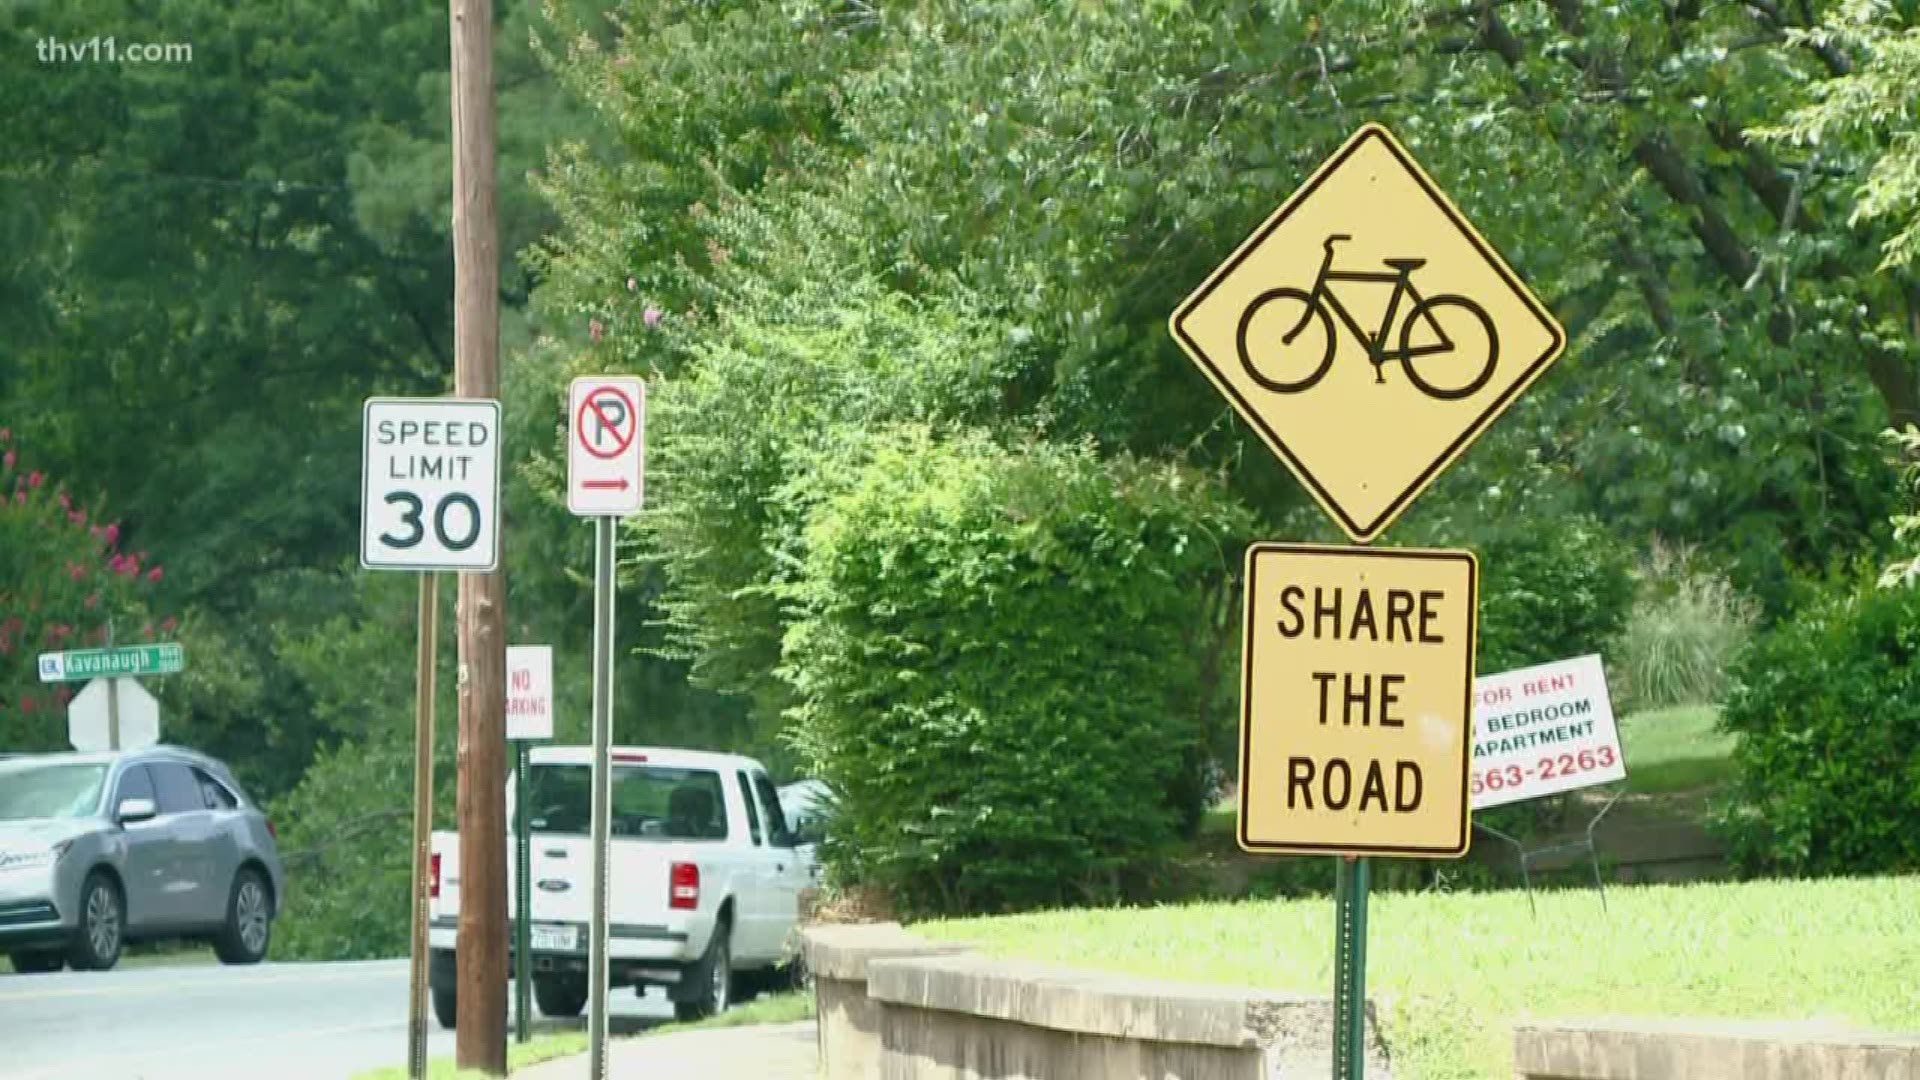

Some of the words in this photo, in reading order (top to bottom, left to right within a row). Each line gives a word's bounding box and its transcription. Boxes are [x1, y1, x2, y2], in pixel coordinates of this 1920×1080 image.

[378, 420, 488, 446] SPEED
[389, 456, 472, 480] LIMIT
[379, 491, 481, 552] 30
[1277, 585, 1444, 643] SHARE
[65, 649, 149, 673] Kavanaugh
[512, 670, 530, 690] NO
[1523, 675, 1574, 697] RENT
[504, 697, 545, 716] ARKING
[1312, 672, 1405, 727] THE
[1487, 698, 1591, 732] BEDROOM
[1474, 720, 1594, 759] APARTMENT
[1287, 756, 1423, 812] ROAD
